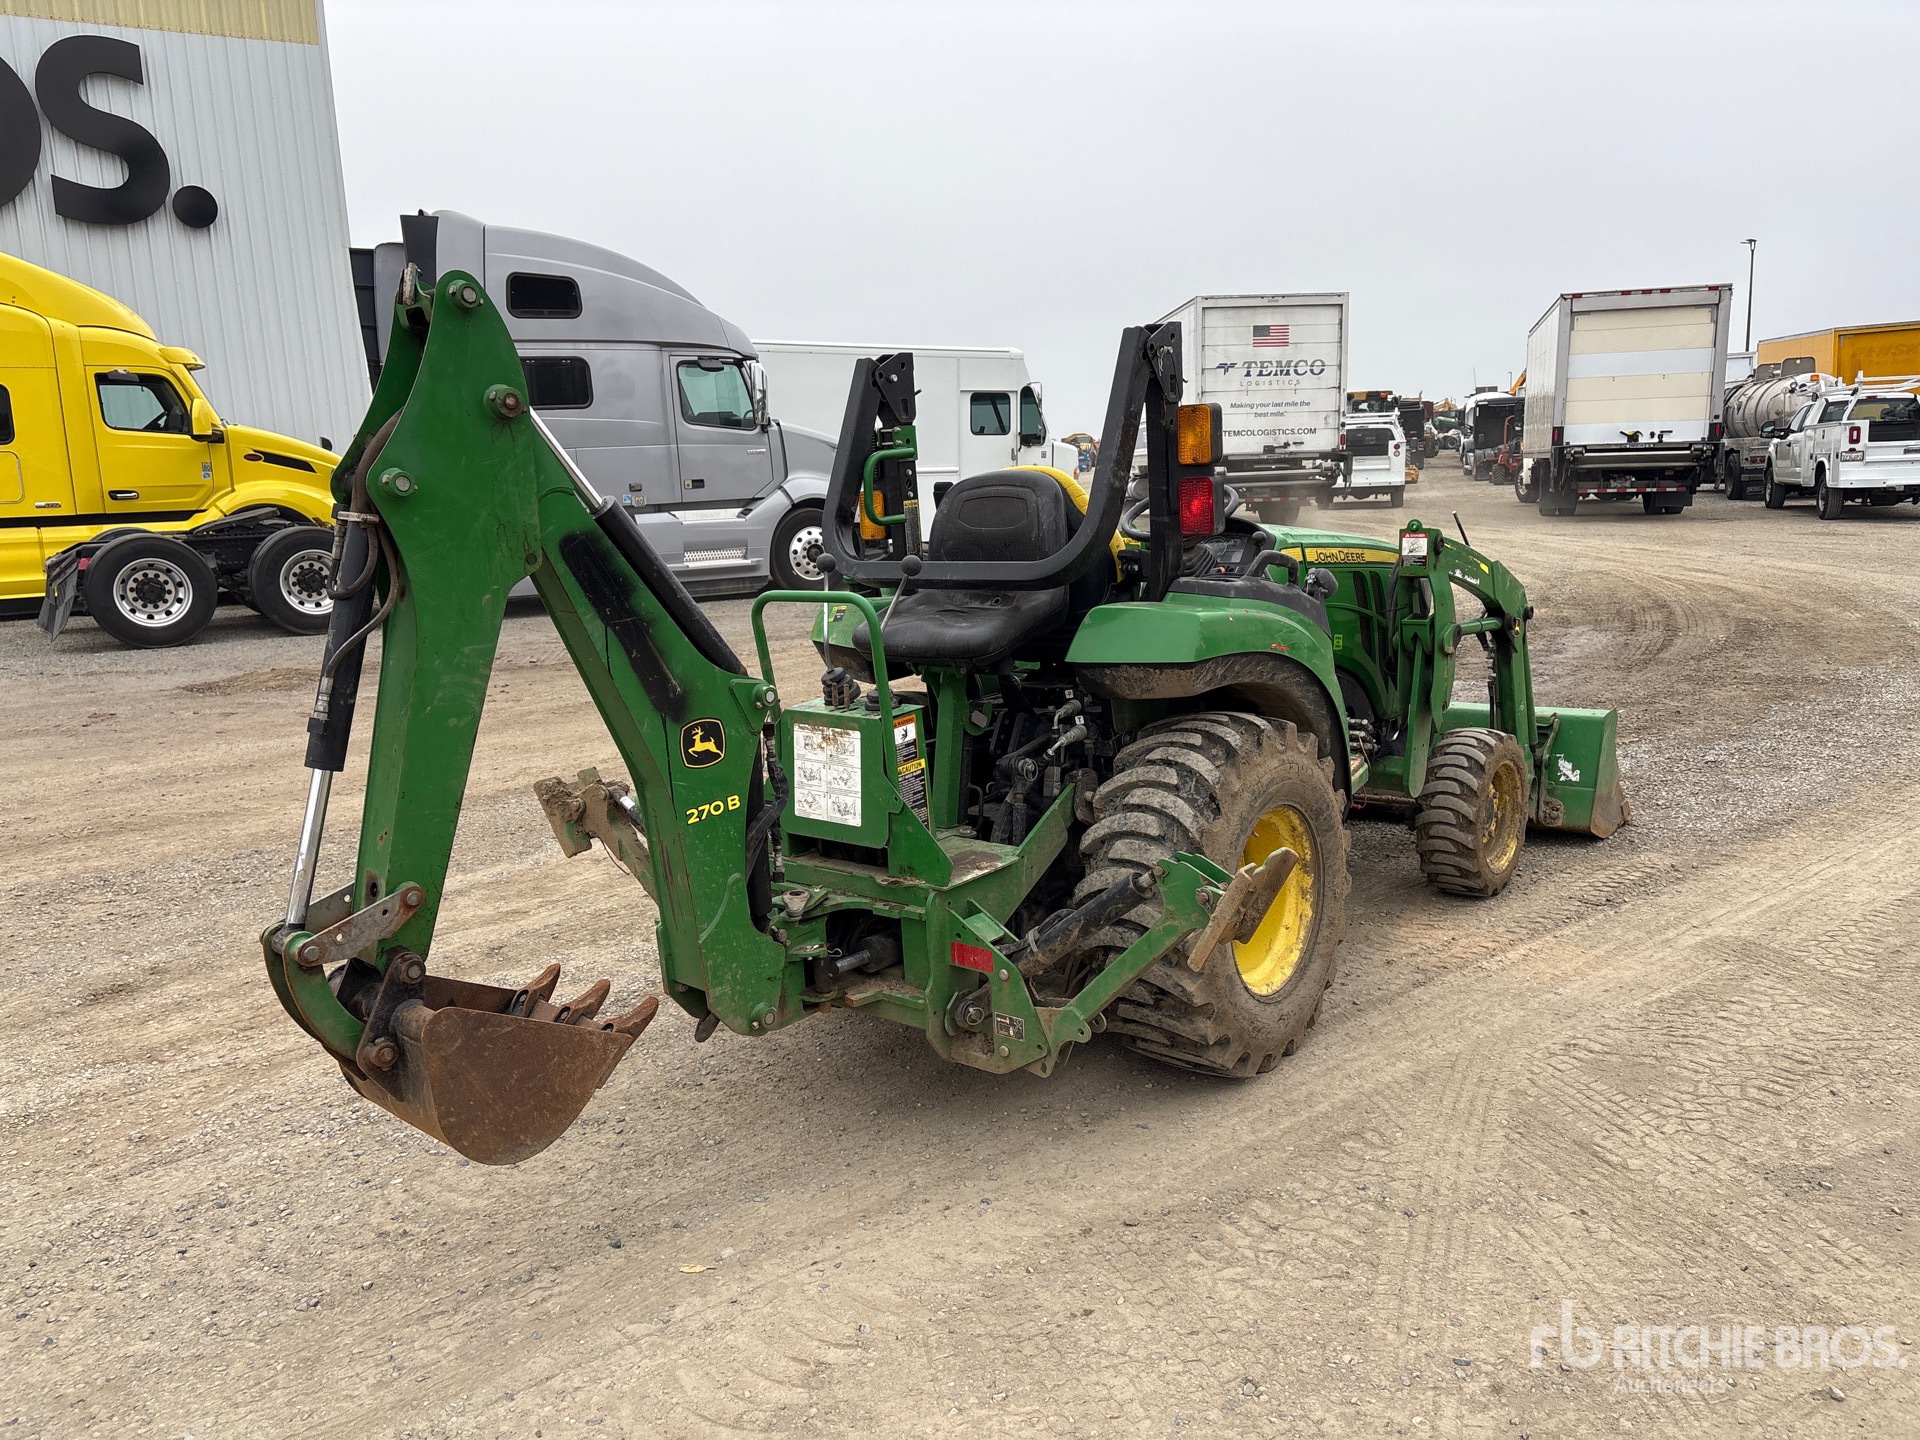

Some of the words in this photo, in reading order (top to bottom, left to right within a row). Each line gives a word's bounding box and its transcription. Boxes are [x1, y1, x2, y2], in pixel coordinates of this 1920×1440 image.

[0, 35, 218, 229] S.
[1242, 359, 1326, 377] TEMCO
[1240, 379, 1301, 387] LOGISTICS
[1223, 427, 1317, 437] TEMCOLOGISTICS.COM
[1313, 551, 1339, 562] JOHN
[1339, 551, 1367, 562] DEERE
[901, 762, 922, 774] CAUTION
[686, 800, 725, 825] 270
[727, 794, 741, 811] B
